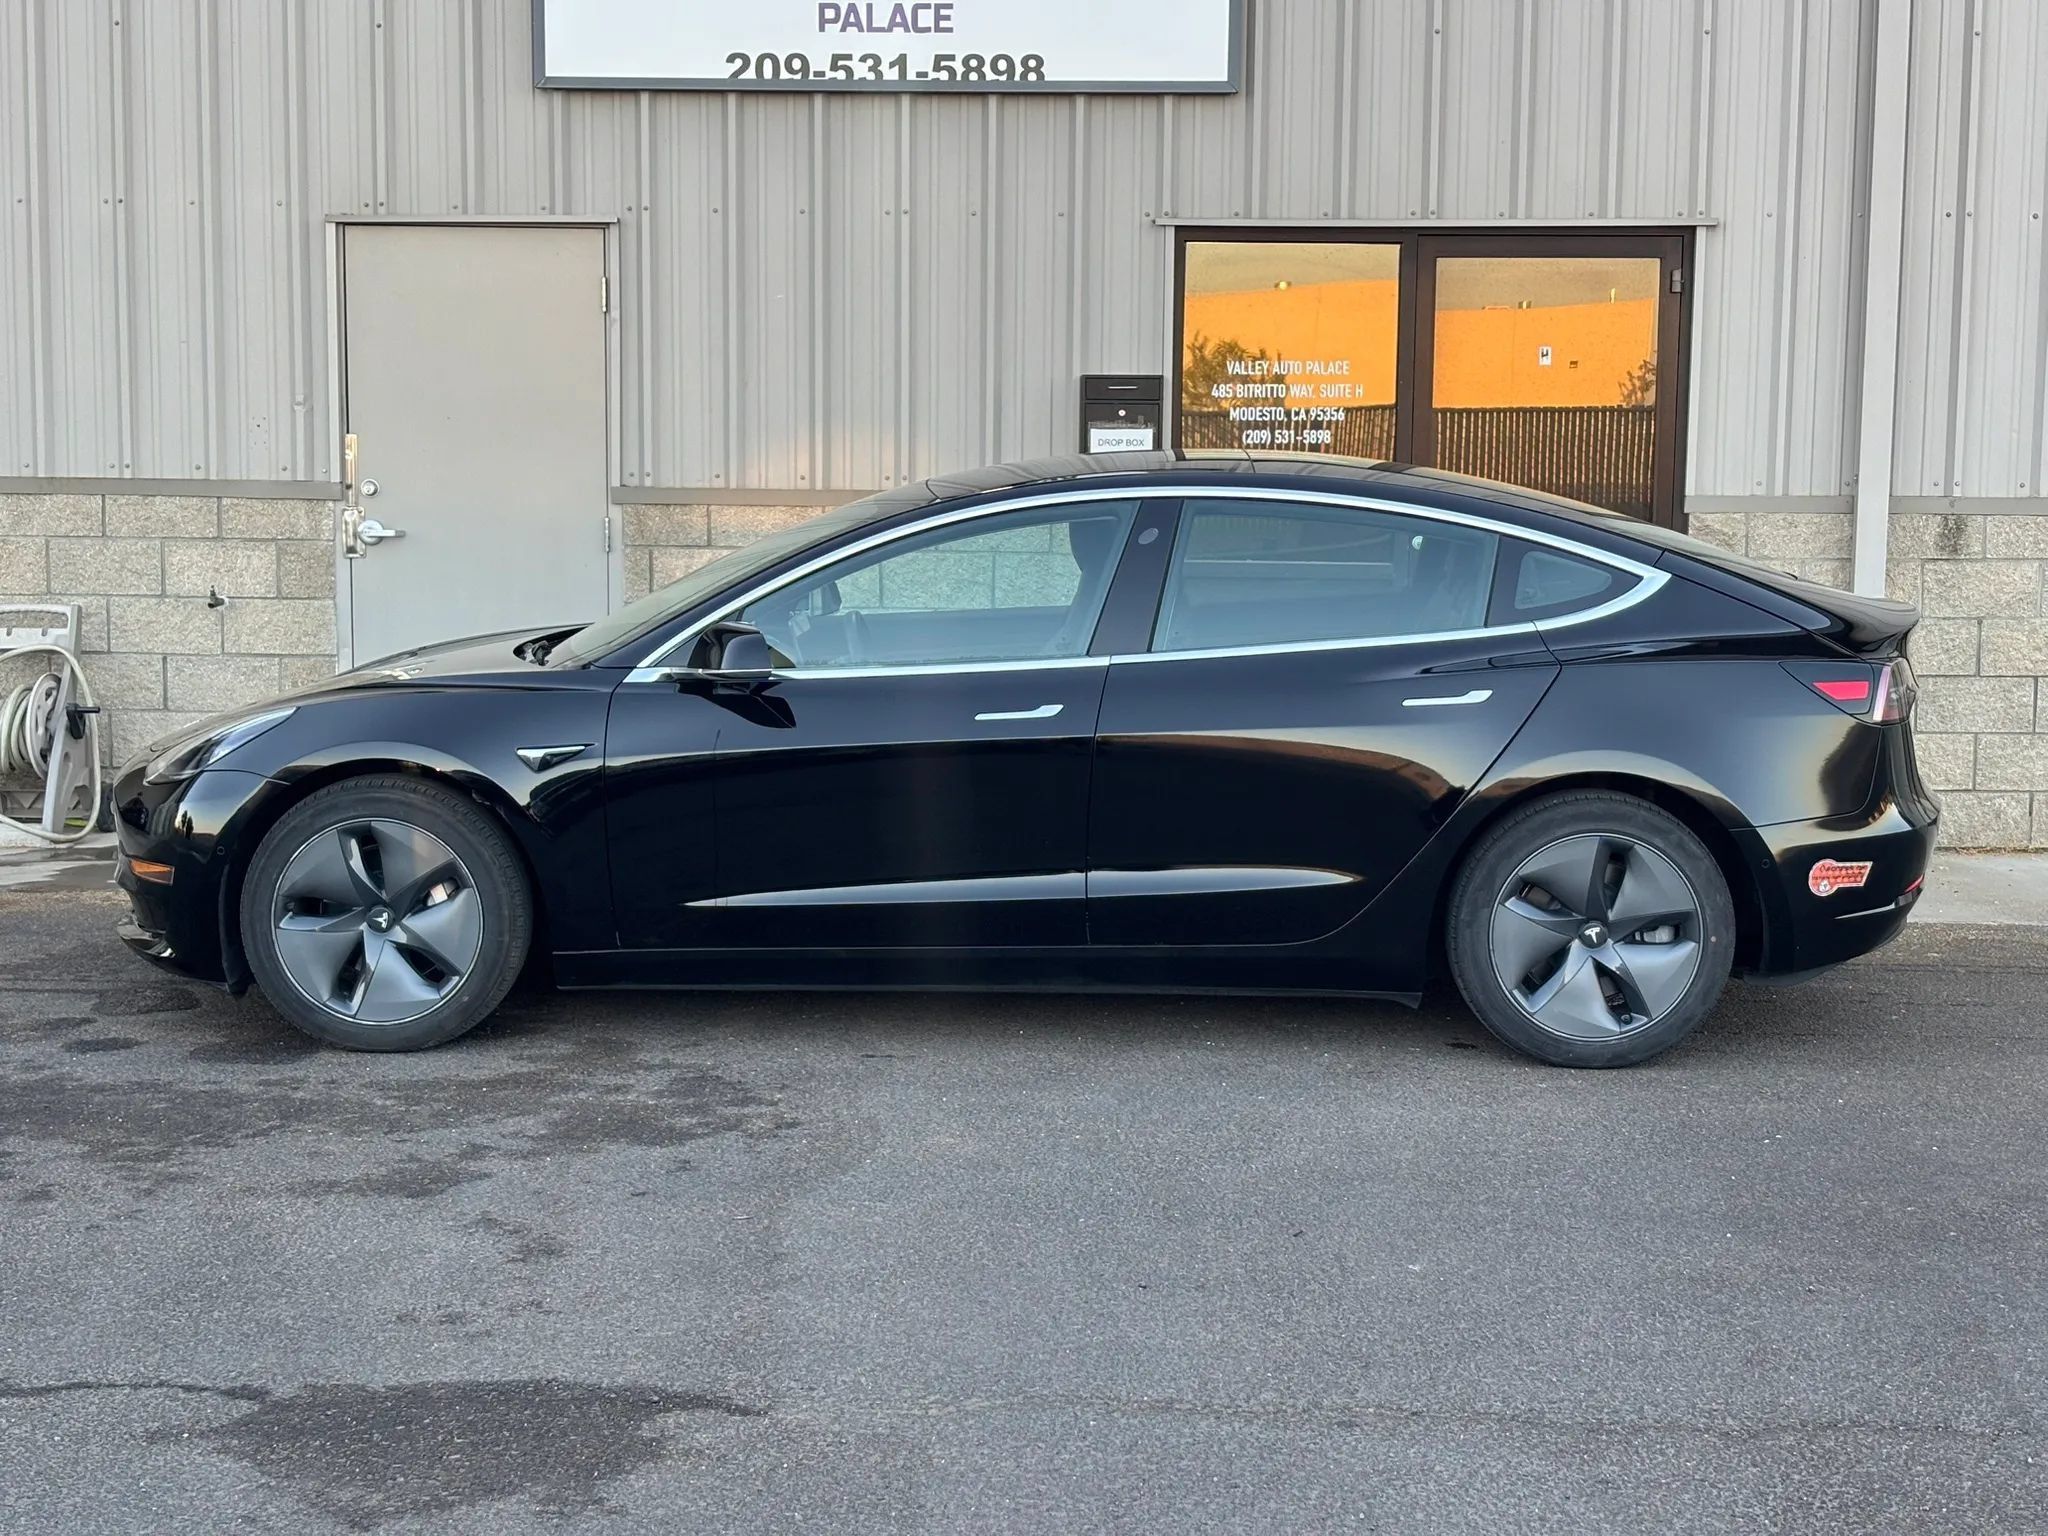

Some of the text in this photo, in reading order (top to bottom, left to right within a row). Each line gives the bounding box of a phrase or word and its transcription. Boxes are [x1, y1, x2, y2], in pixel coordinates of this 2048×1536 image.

[818, 2, 954, 33] PALACE
[725, 52, 1046, 82] 209-531-5898
[1226, 360, 1350, 375] VALLEY AUTO PALACE
[1211, 383, 1233, 398] 485
[1236, 383, 1287, 398] BITRITTO
[1319, 383, 1352, 398] SUITE
[1355, 383, 1364, 398] H
[1291, 407, 1307, 421] CA
[1309, 407, 1345, 421] 95356
[1097, 438, 1145, 447] DROP BOX
[1242, 428, 1331, 446] (209) 531-5898
